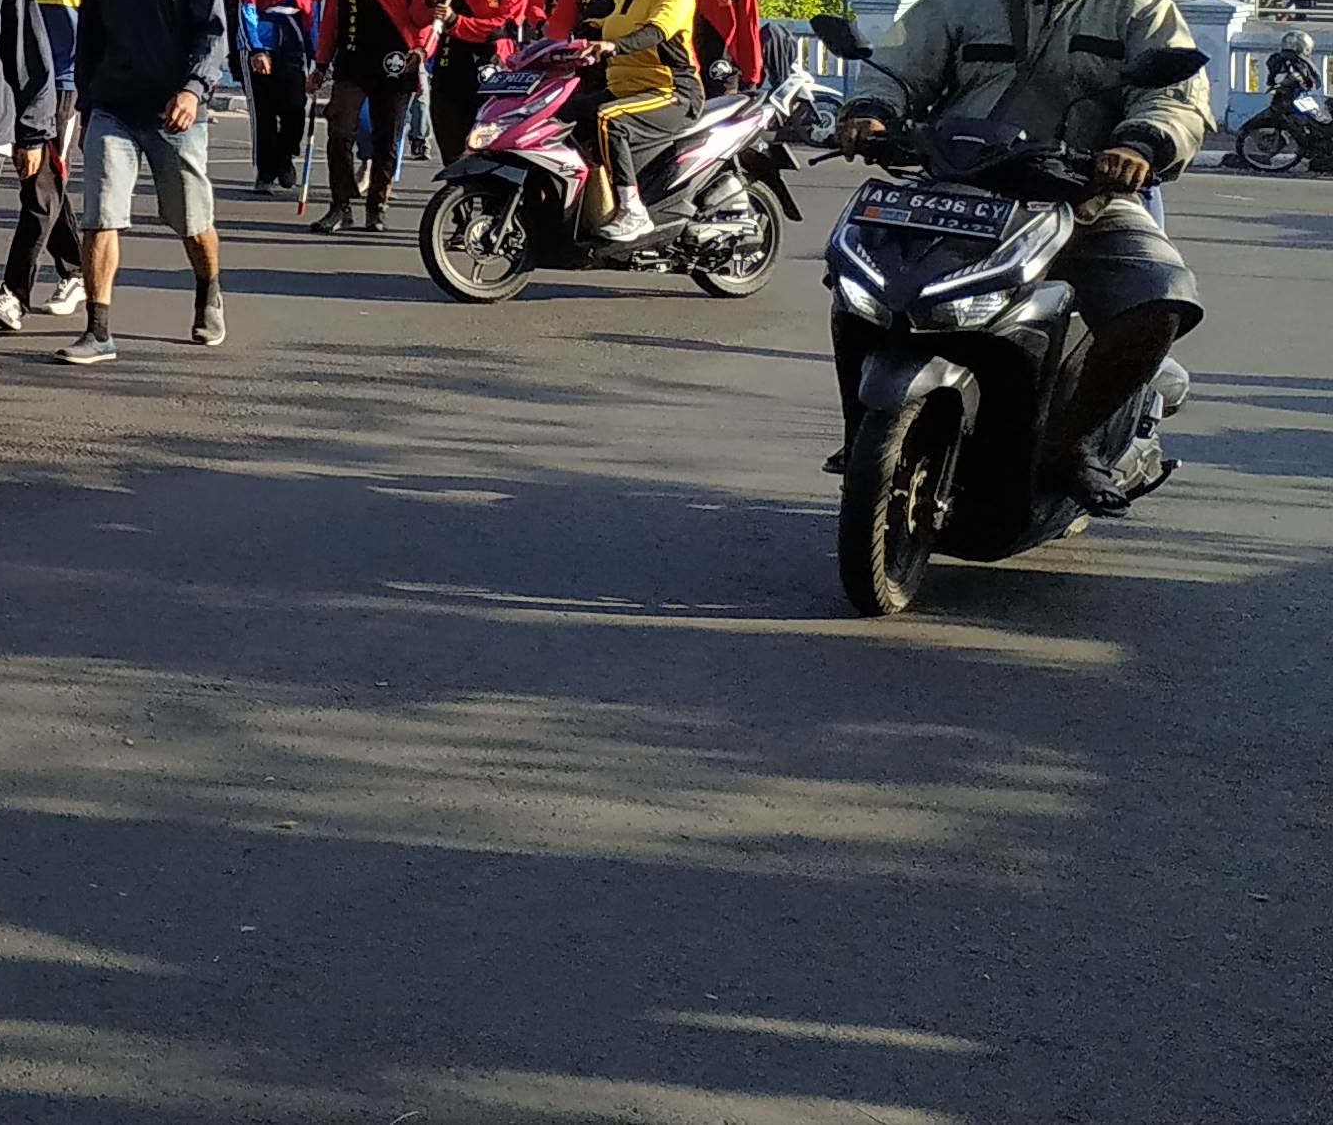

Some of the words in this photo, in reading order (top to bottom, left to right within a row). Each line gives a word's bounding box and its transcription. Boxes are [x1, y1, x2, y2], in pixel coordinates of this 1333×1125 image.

[869, 188, 900, 204] AG
[909, 194, 967, 214] 6436
[974, 201, 1005, 219] CY
